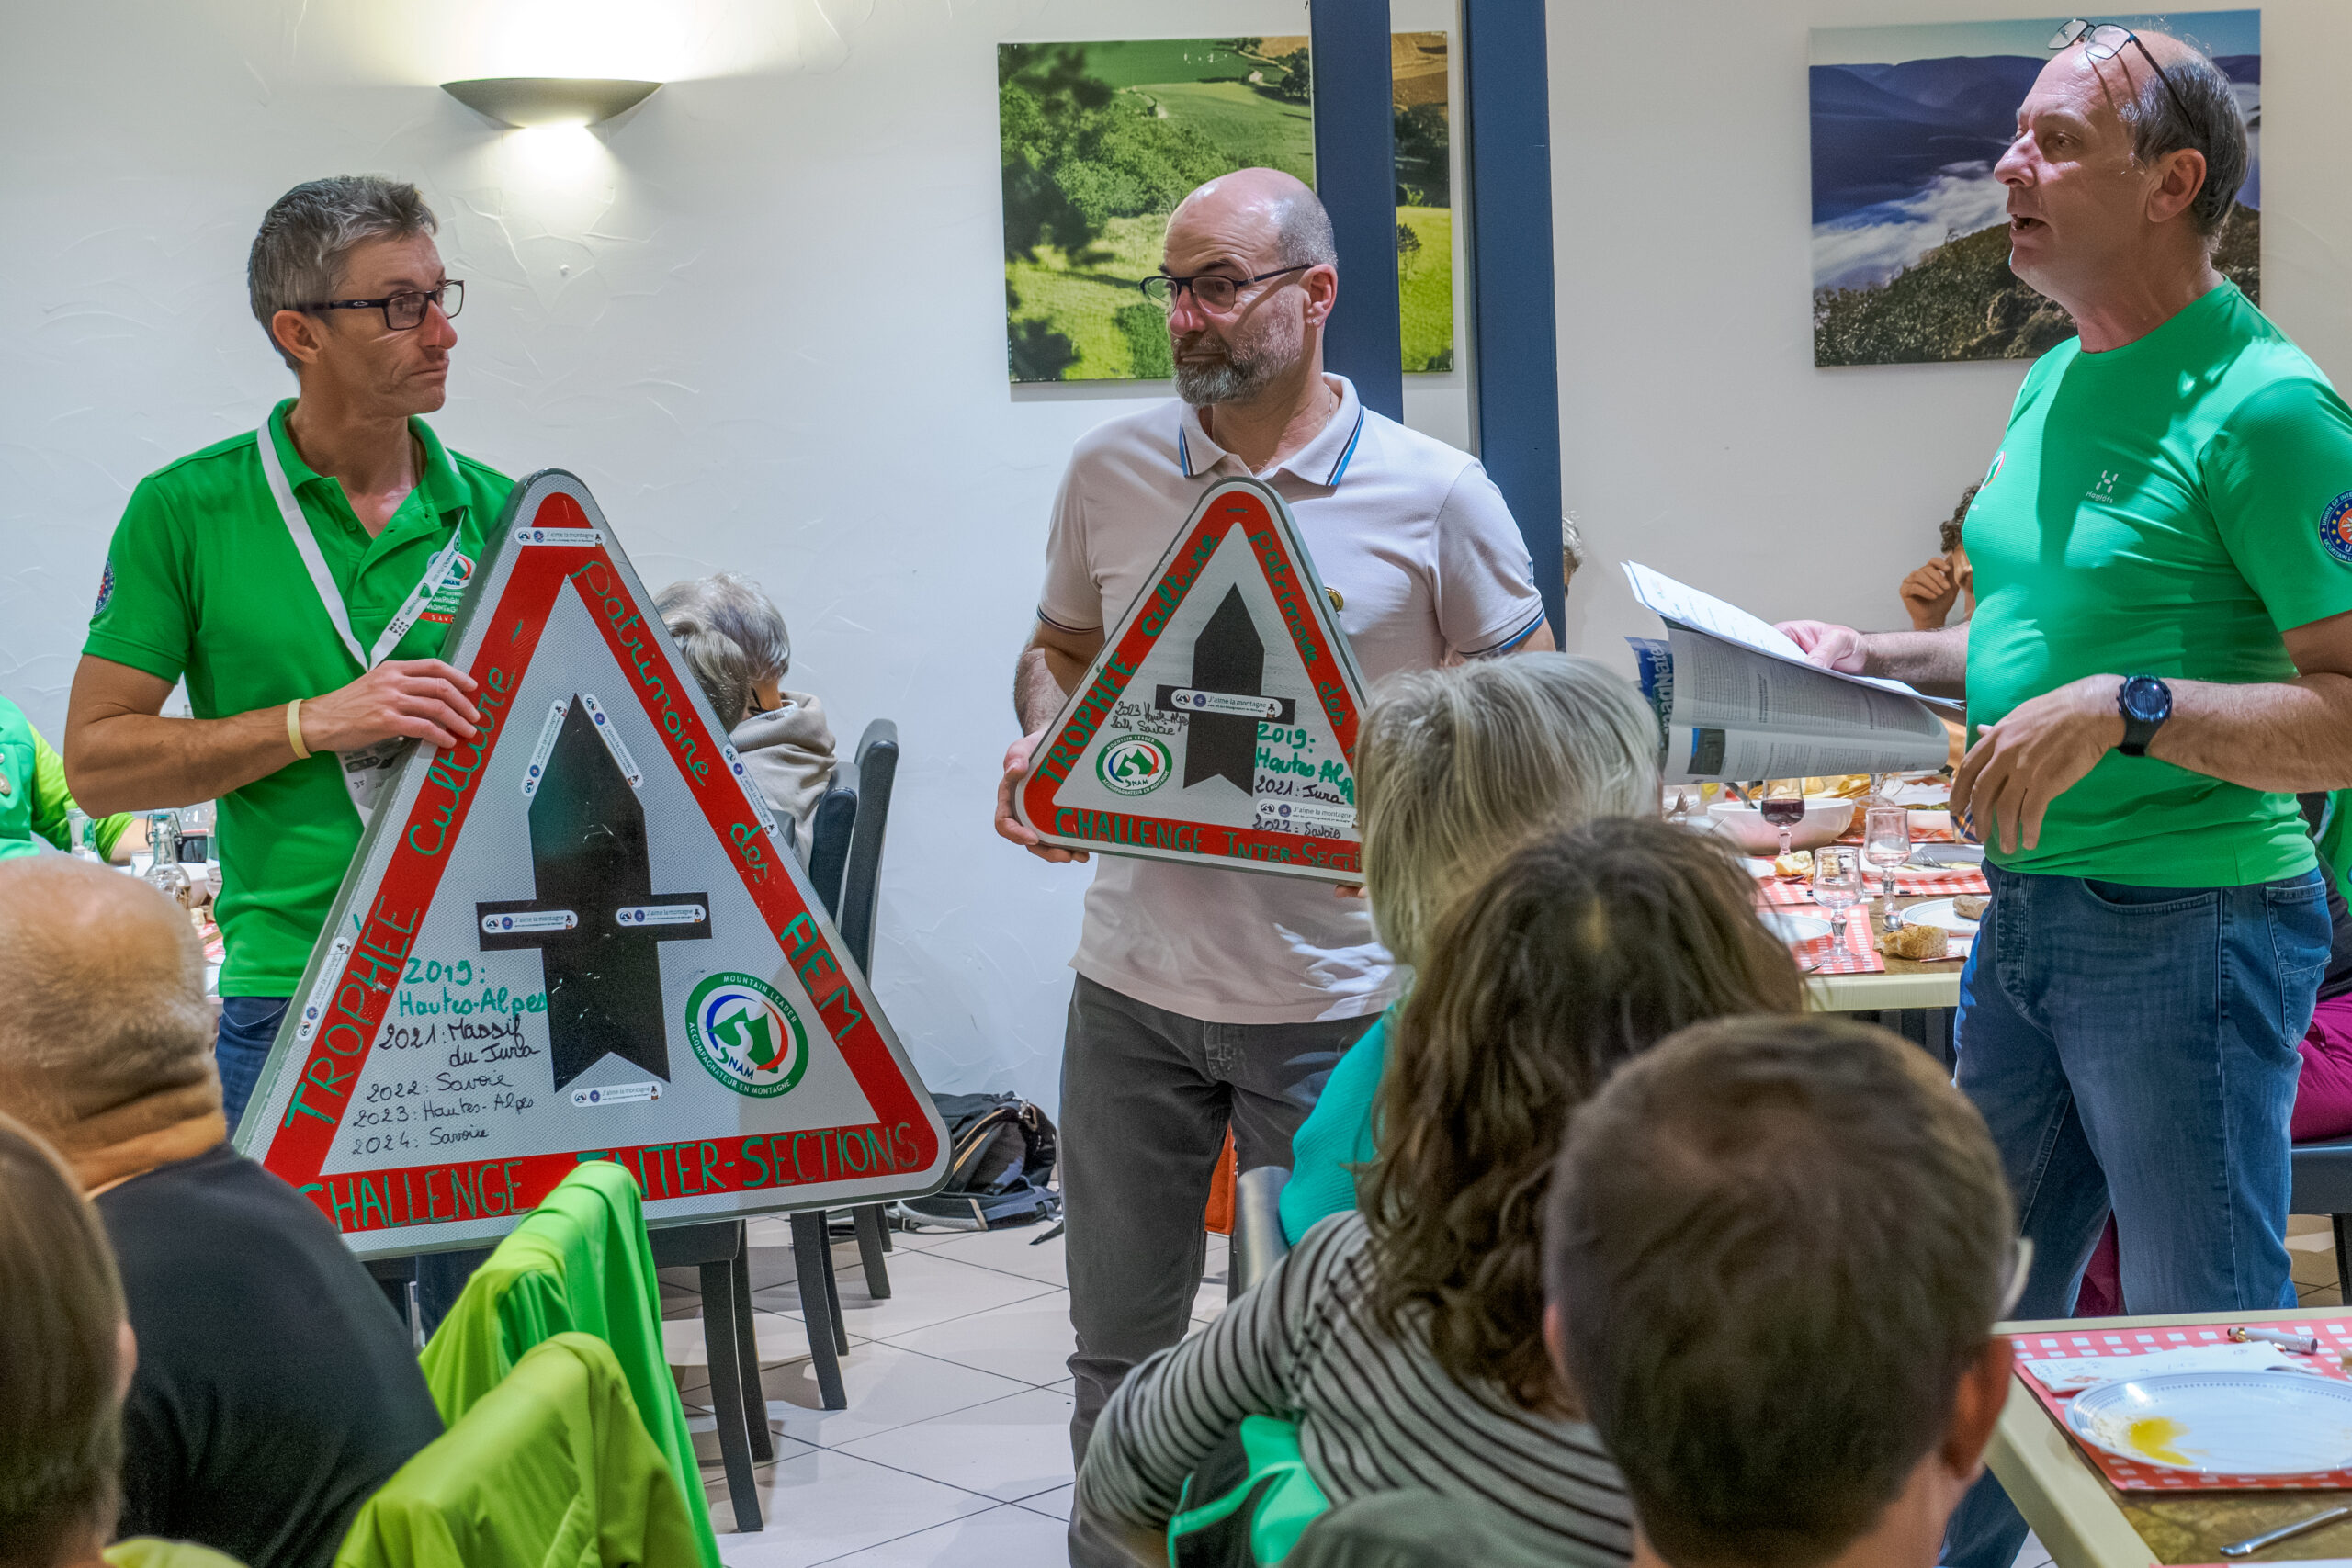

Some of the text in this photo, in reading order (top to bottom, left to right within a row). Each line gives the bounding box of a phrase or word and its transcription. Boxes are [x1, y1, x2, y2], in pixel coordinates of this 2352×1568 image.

[1141, 534, 1219, 637] Culture
[1248, 530, 1346, 727] Patrimoine des
[1208, 695, 1228, 704] J'aime
[1236, 700, 1266, 708] montagne
[570, 560, 709, 787] Patrimoine
[730, 822, 768, 884] des
[1107, 736, 1133, 750] MOUNTAIN
[408, 668, 515, 855] Culture
[1124, 779, 1148, 787] SNAM
[1302, 784, 1345, 805] Jura
[1293, 806, 1315, 814] J'aime
[1321, 809, 1352, 819] montagne
[1055, 807, 1205, 855] CHALLENGE
[399, 986, 548, 1021] Hautes-Alpes
[723, 975, 797, 1023] MOUNTAIN LEADER
[447, 1013, 526, 1052] Massif
[449, 1043, 542, 1067] du Jura
[688, 1021, 791, 1095] ACCOMPAGNATEUR EN MONTAGNE
[716, 1046, 755, 1080] SNAM
[436, 1070, 514, 1091] Savoie
[429, 1124, 490, 1145] Savoie
[297, 1160, 537, 1234] HALLENGE
